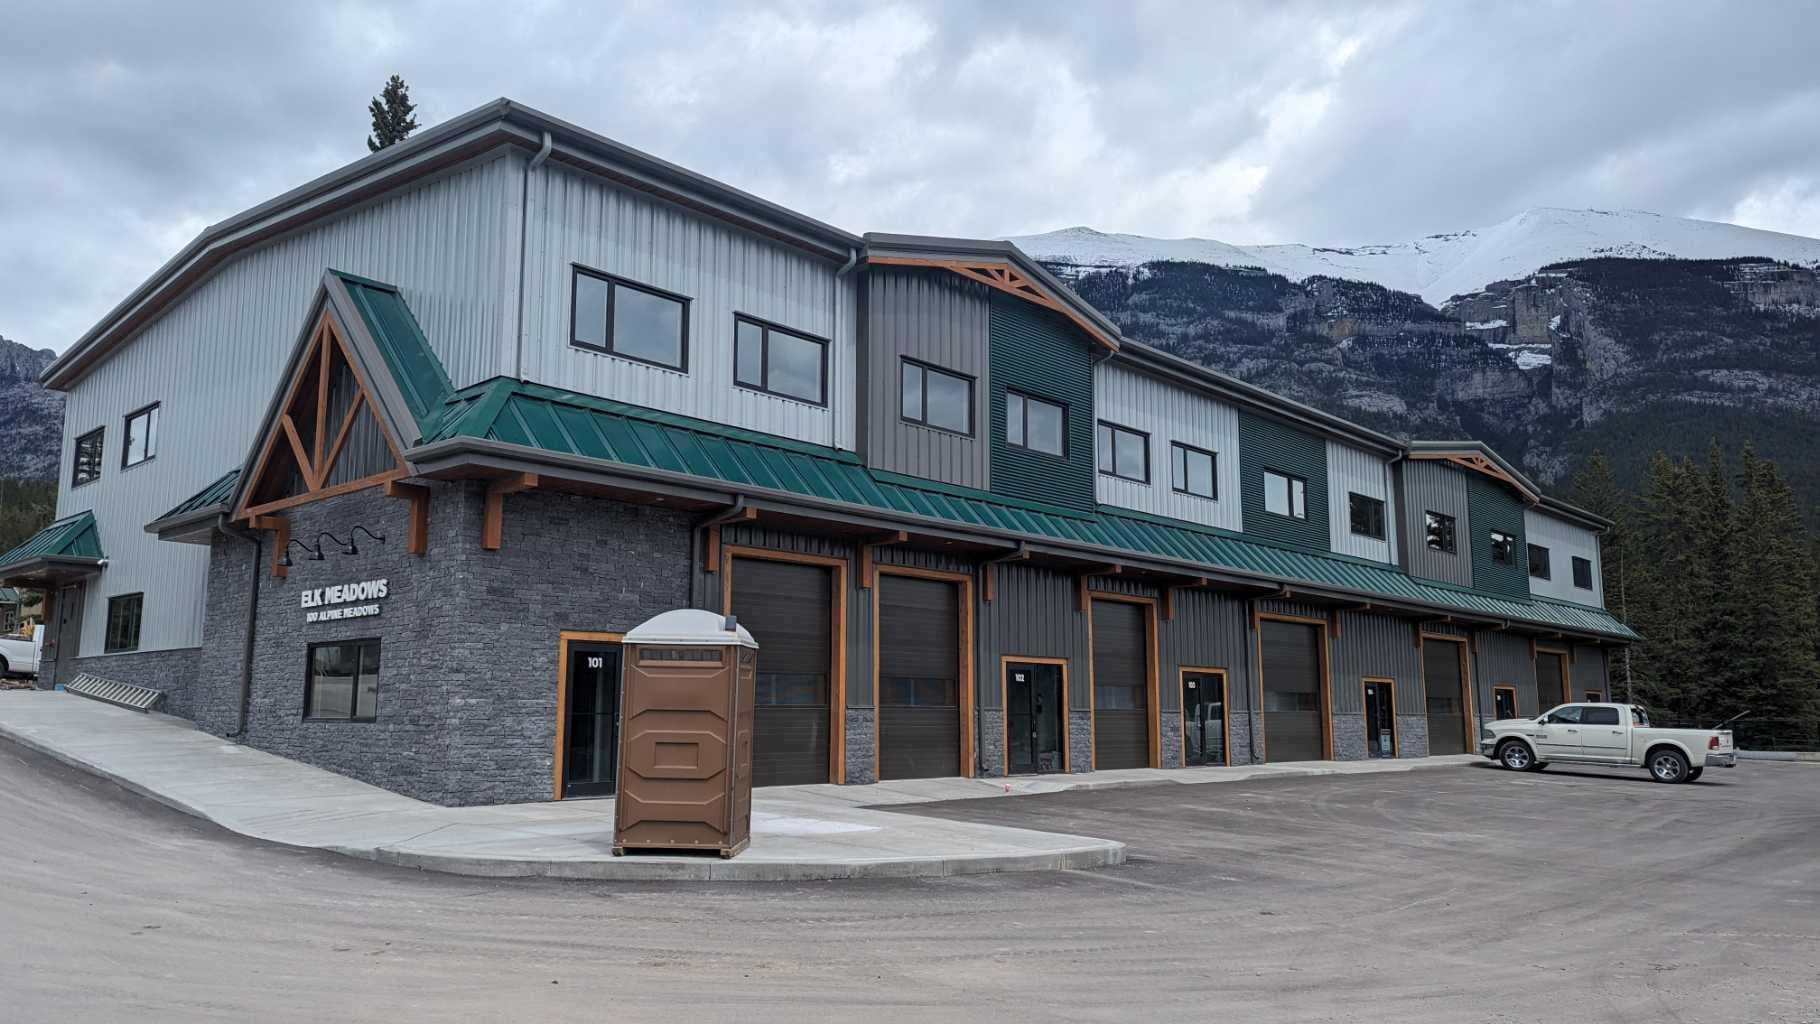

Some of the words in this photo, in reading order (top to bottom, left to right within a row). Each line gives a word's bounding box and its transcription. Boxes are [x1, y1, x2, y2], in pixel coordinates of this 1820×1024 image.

[301, 588, 322, 608] ELK
[324, 578, 388, 604] MEADOWS
[318, 609, 343, 621] ALPINE
[343, 604, 380, 618] MEADOWS
[587, 656, 603, 669] 101
